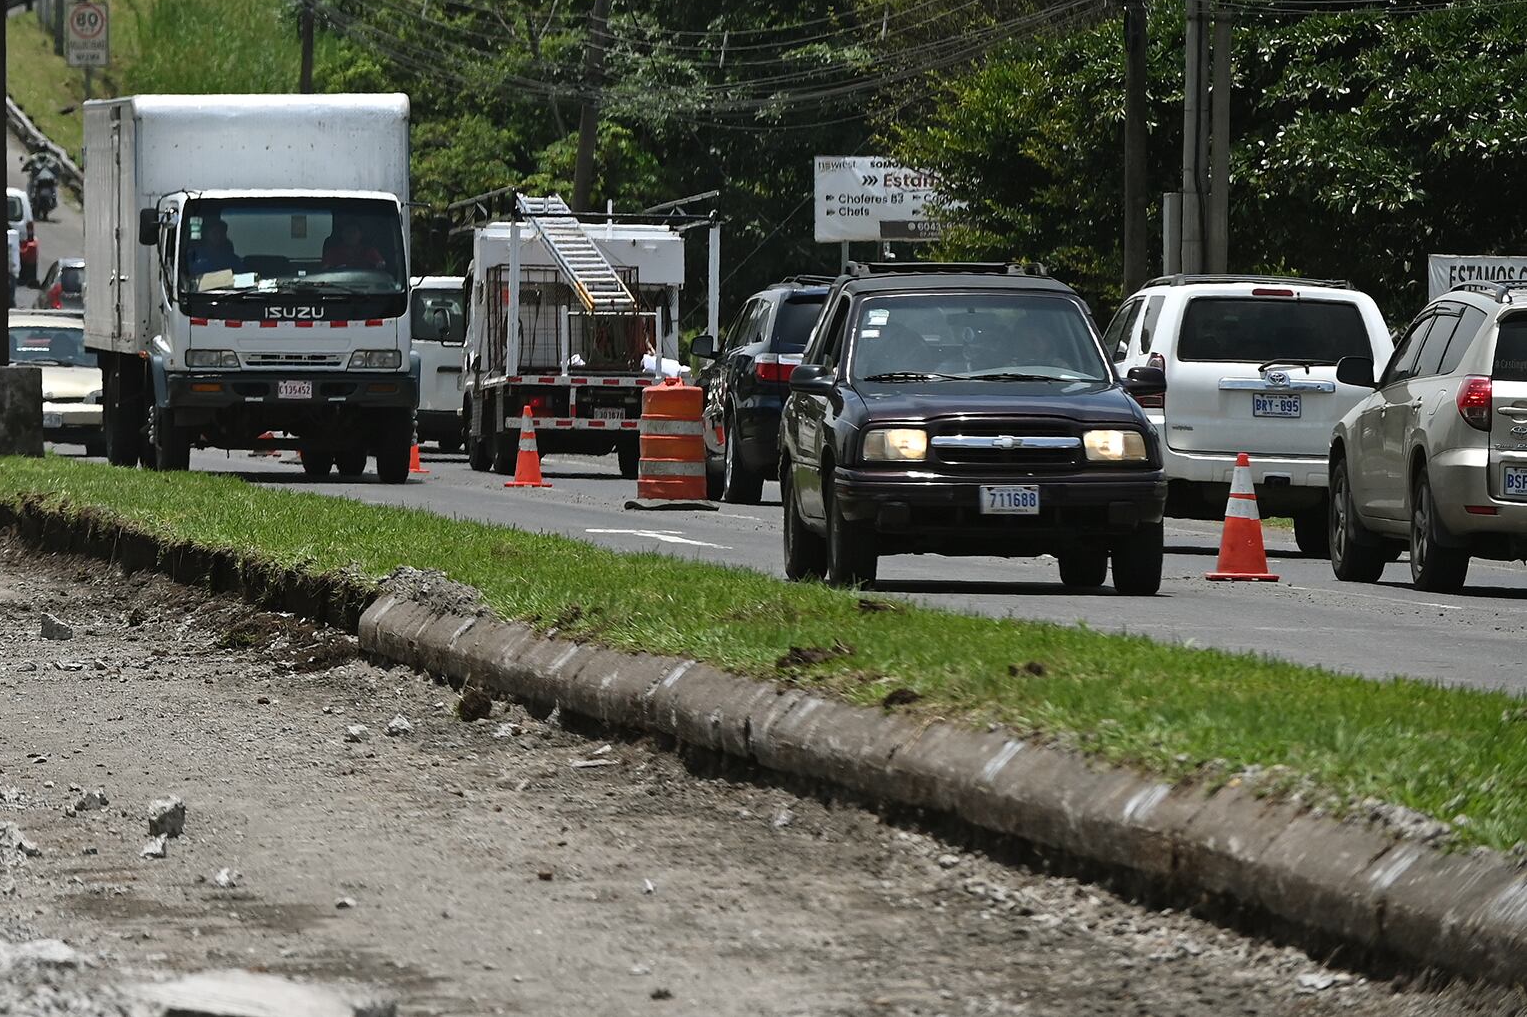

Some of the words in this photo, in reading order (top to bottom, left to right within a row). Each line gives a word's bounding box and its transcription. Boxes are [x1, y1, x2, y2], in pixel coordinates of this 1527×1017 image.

[838, 193, 887, 205] Choferes
[838, 206, 870, 217] Chefs
[1449, 265, 1515, 288] ESTAMOS
[264, 306, 324, 319] ISUZU
[1255, 399, 1300, 413] BRY-895
[989, 492, 1036, 508] 711688
